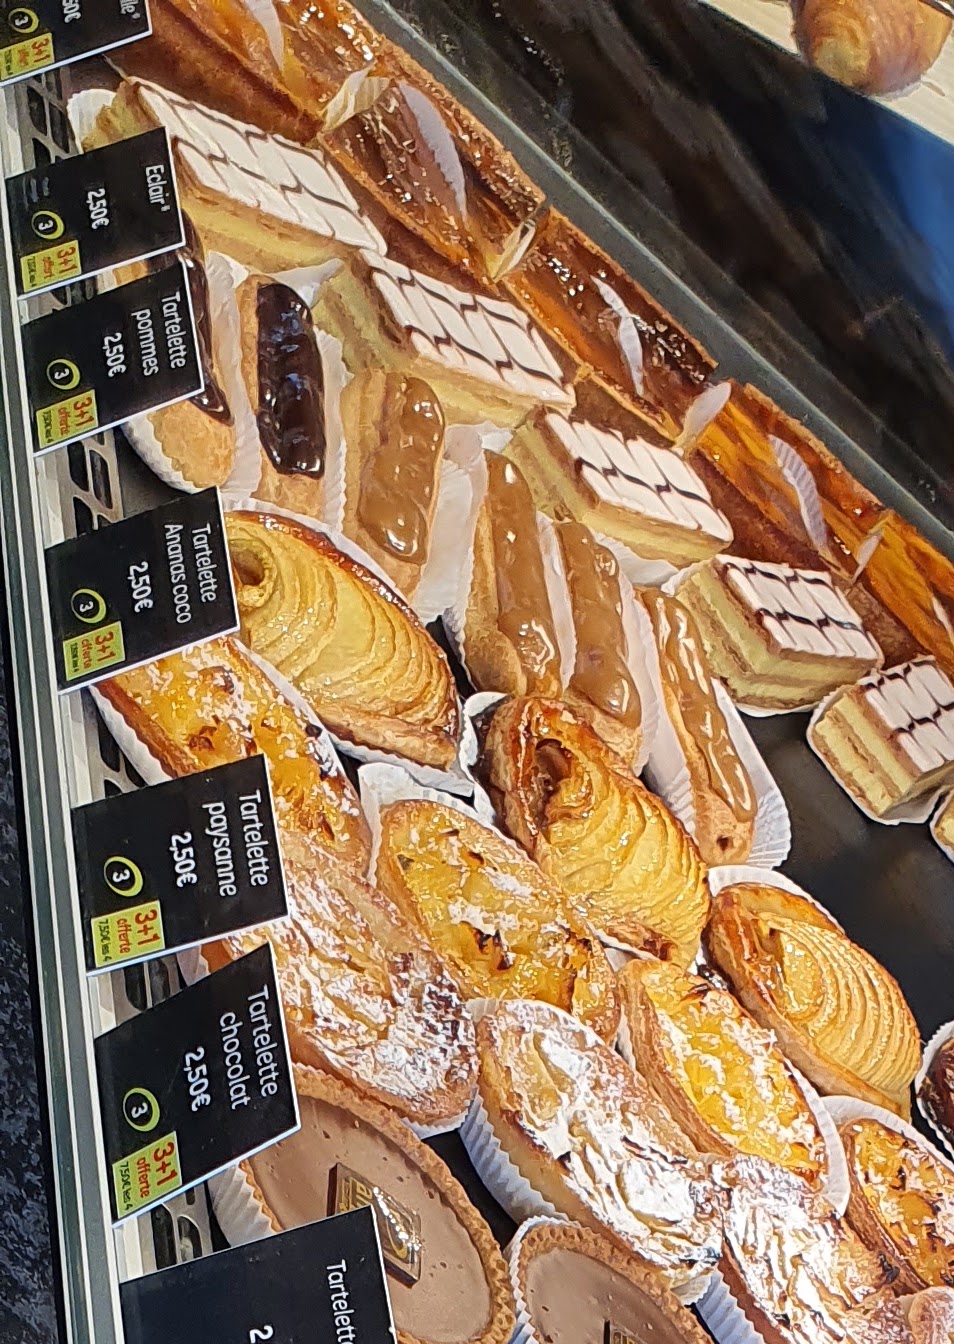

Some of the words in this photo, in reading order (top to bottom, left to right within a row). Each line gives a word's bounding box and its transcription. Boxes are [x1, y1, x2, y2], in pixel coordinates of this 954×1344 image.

[14, 17, 28, 26] 3
[38, 220, 53, 230] 3
[86, 188, 109, 229] 2,50€
[57, 247, 78, 273] 3+1
[131, 309, 159, 376] pommes
[161, 291, 187, 369] Tartelette
[54, 368, 69, 380] 3
[102, 332, 126, 377] 2,50€
[73, 397, 94, 426] 3+1
[164, 524, 186, 583] Ananas
[192, 523, 217, 603] Tartelette
[79, 601, 94, 612] 3
[127, 562, 153, 613] 2,50€
[173, 584, 192, 624] coco
[95, 631, 116, 662] 3+1
[202, 801, 237, 897] paysanne
[239, 789, 270, 887] Tartelette
[112, 870, 131, 883] 3
[170, 831, 197, 888] 2,50€
[116, 918, 132, 953] offerte
[135, 909, 161, 945] 3+1
[220, 1012, 250, 1109] chocolat
[248, 984, 278, 1097] Tartelette
[184, 1046, 211, 1112] 2,50€
[131, 1102, 148, 1119] 3
[136, 1157, 150, 1198] offerte
[153, 1142, 178, 1186] 3+1
